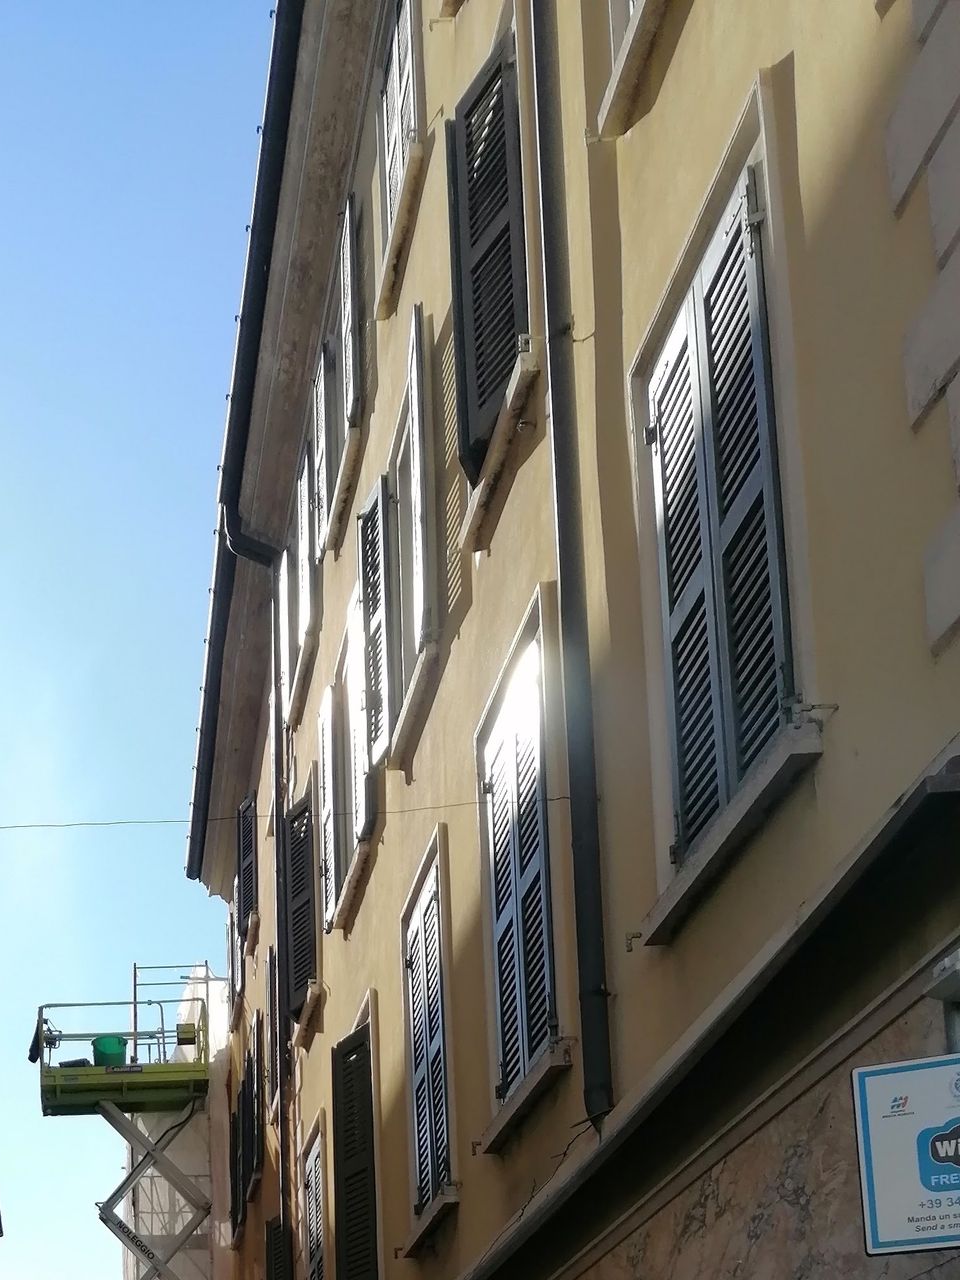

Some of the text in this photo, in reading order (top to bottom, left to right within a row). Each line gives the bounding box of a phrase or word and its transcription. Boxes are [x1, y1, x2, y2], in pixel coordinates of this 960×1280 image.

[919, 1198, 942, 1209] +39
[907, 1213, 936, 1224] Manda
[939, 1212, 951, 1220] un
[915, 1223, 938, 1233] Send
[116, 1220, 155, 1260] NOLEGGIO
